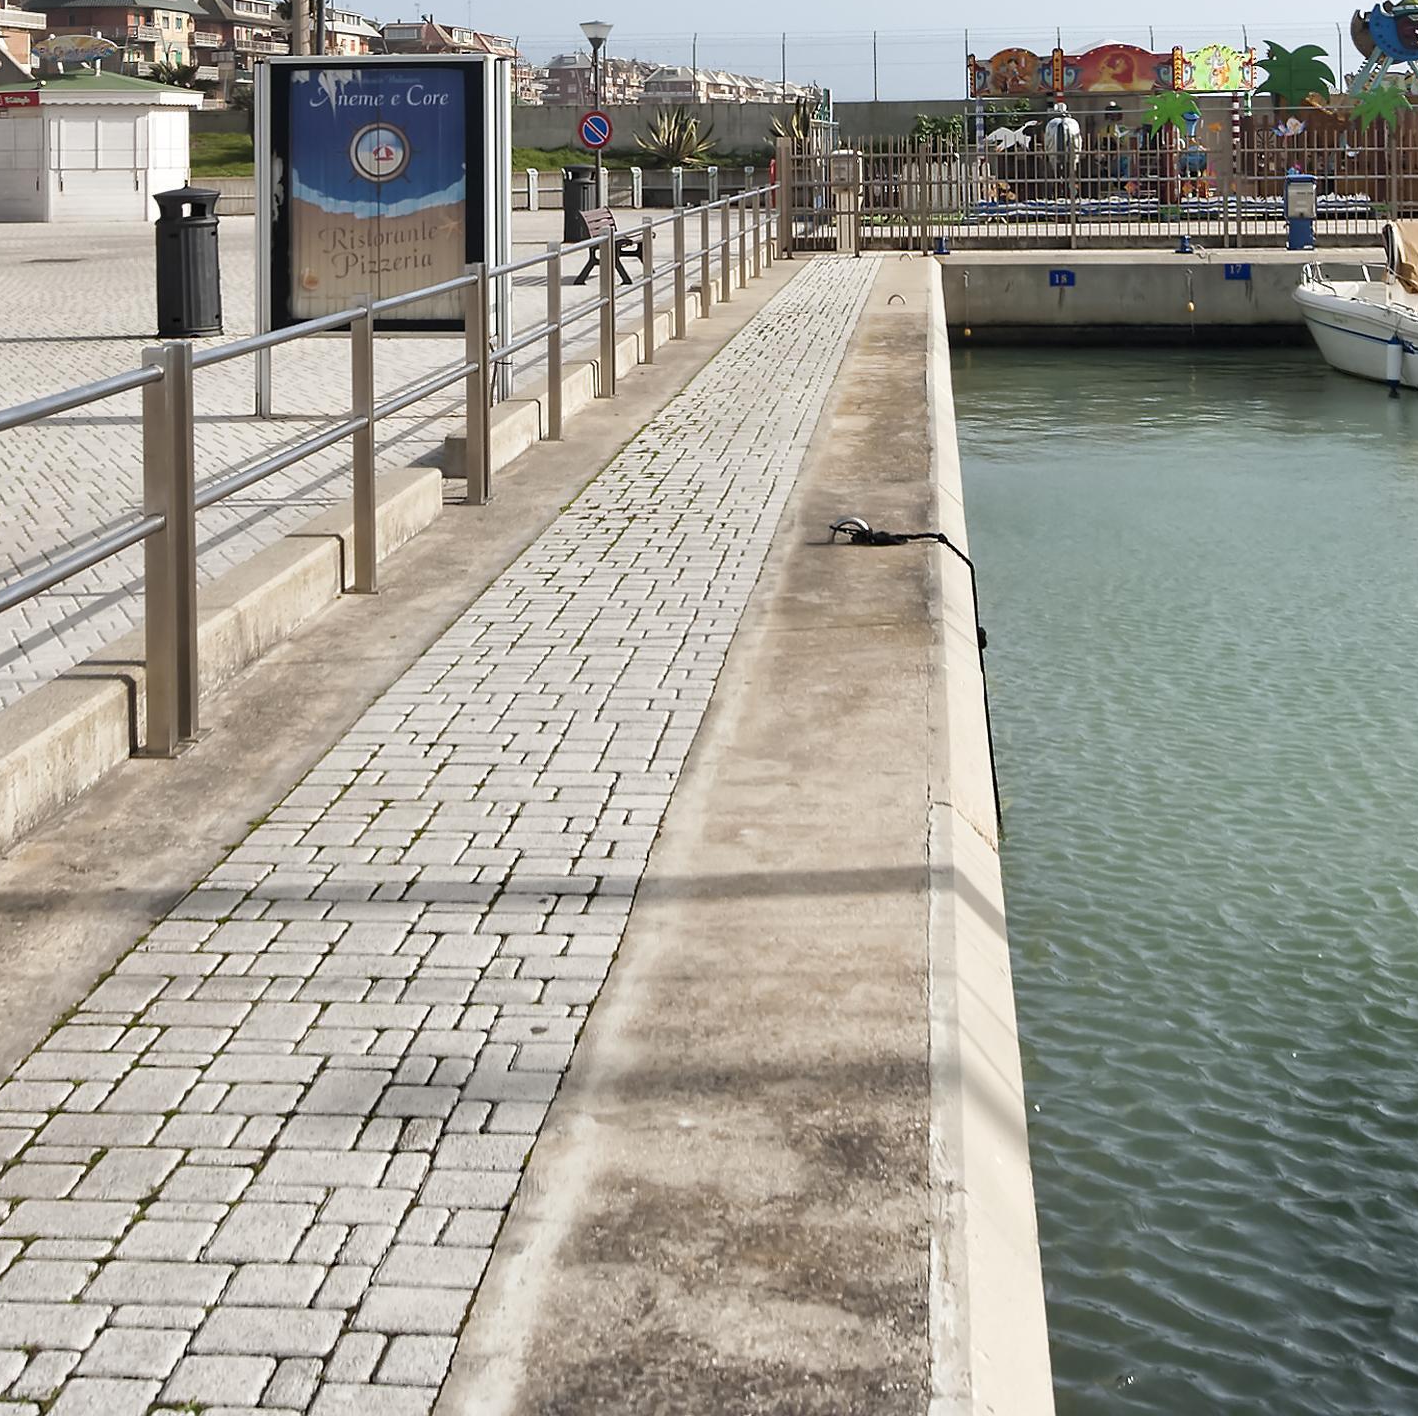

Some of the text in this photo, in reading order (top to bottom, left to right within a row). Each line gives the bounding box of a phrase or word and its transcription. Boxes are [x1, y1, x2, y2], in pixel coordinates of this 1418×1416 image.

[391, 94, 401, 106] e
[407, 84, 449, 106] Core
[318, 220, 438, 253] Ristorante
[331, 248, 433, 279] Pizzeria
[1230, 264, 1242, 274] 17
